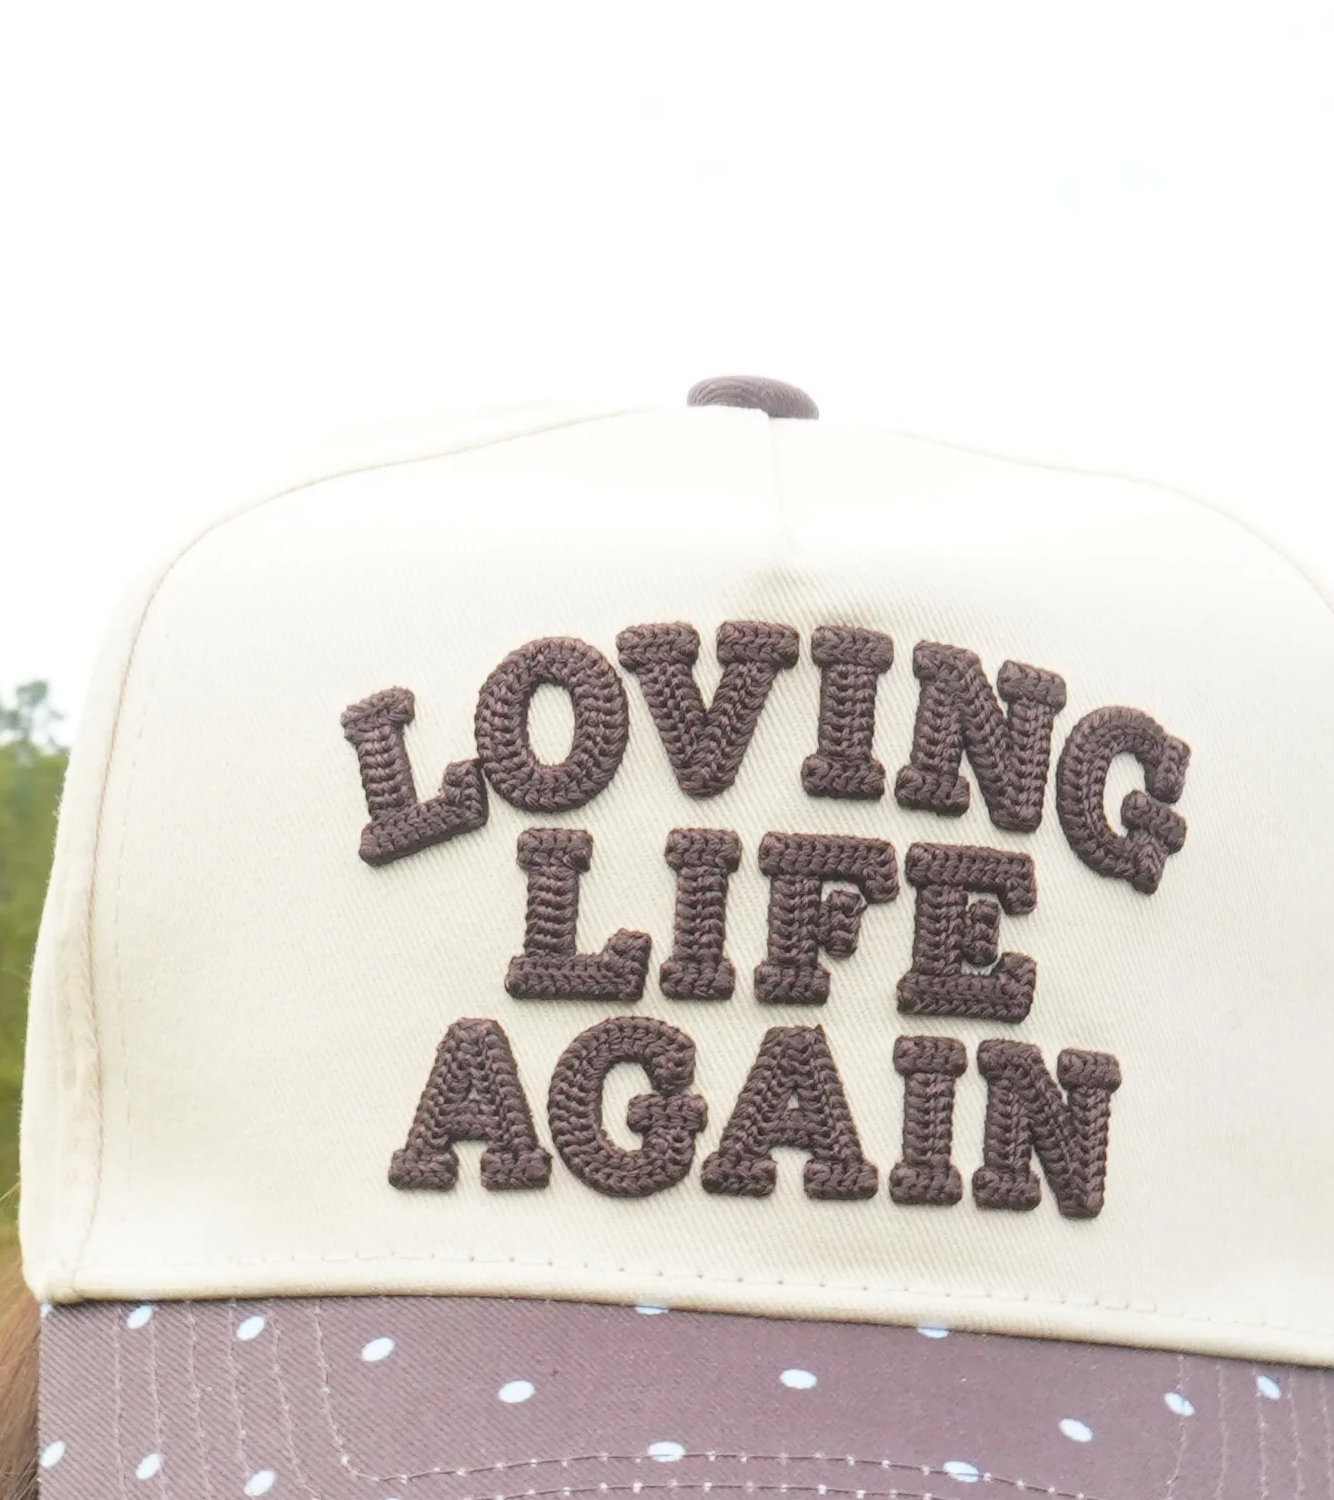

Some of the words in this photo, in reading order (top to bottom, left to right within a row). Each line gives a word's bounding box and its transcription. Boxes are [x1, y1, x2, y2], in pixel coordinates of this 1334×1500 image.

[341, 621, 1190, 896] LOVING
[505, 828, 1037, 1024] LIFE
[388, 1016, 1121, 1220] AGAIN
